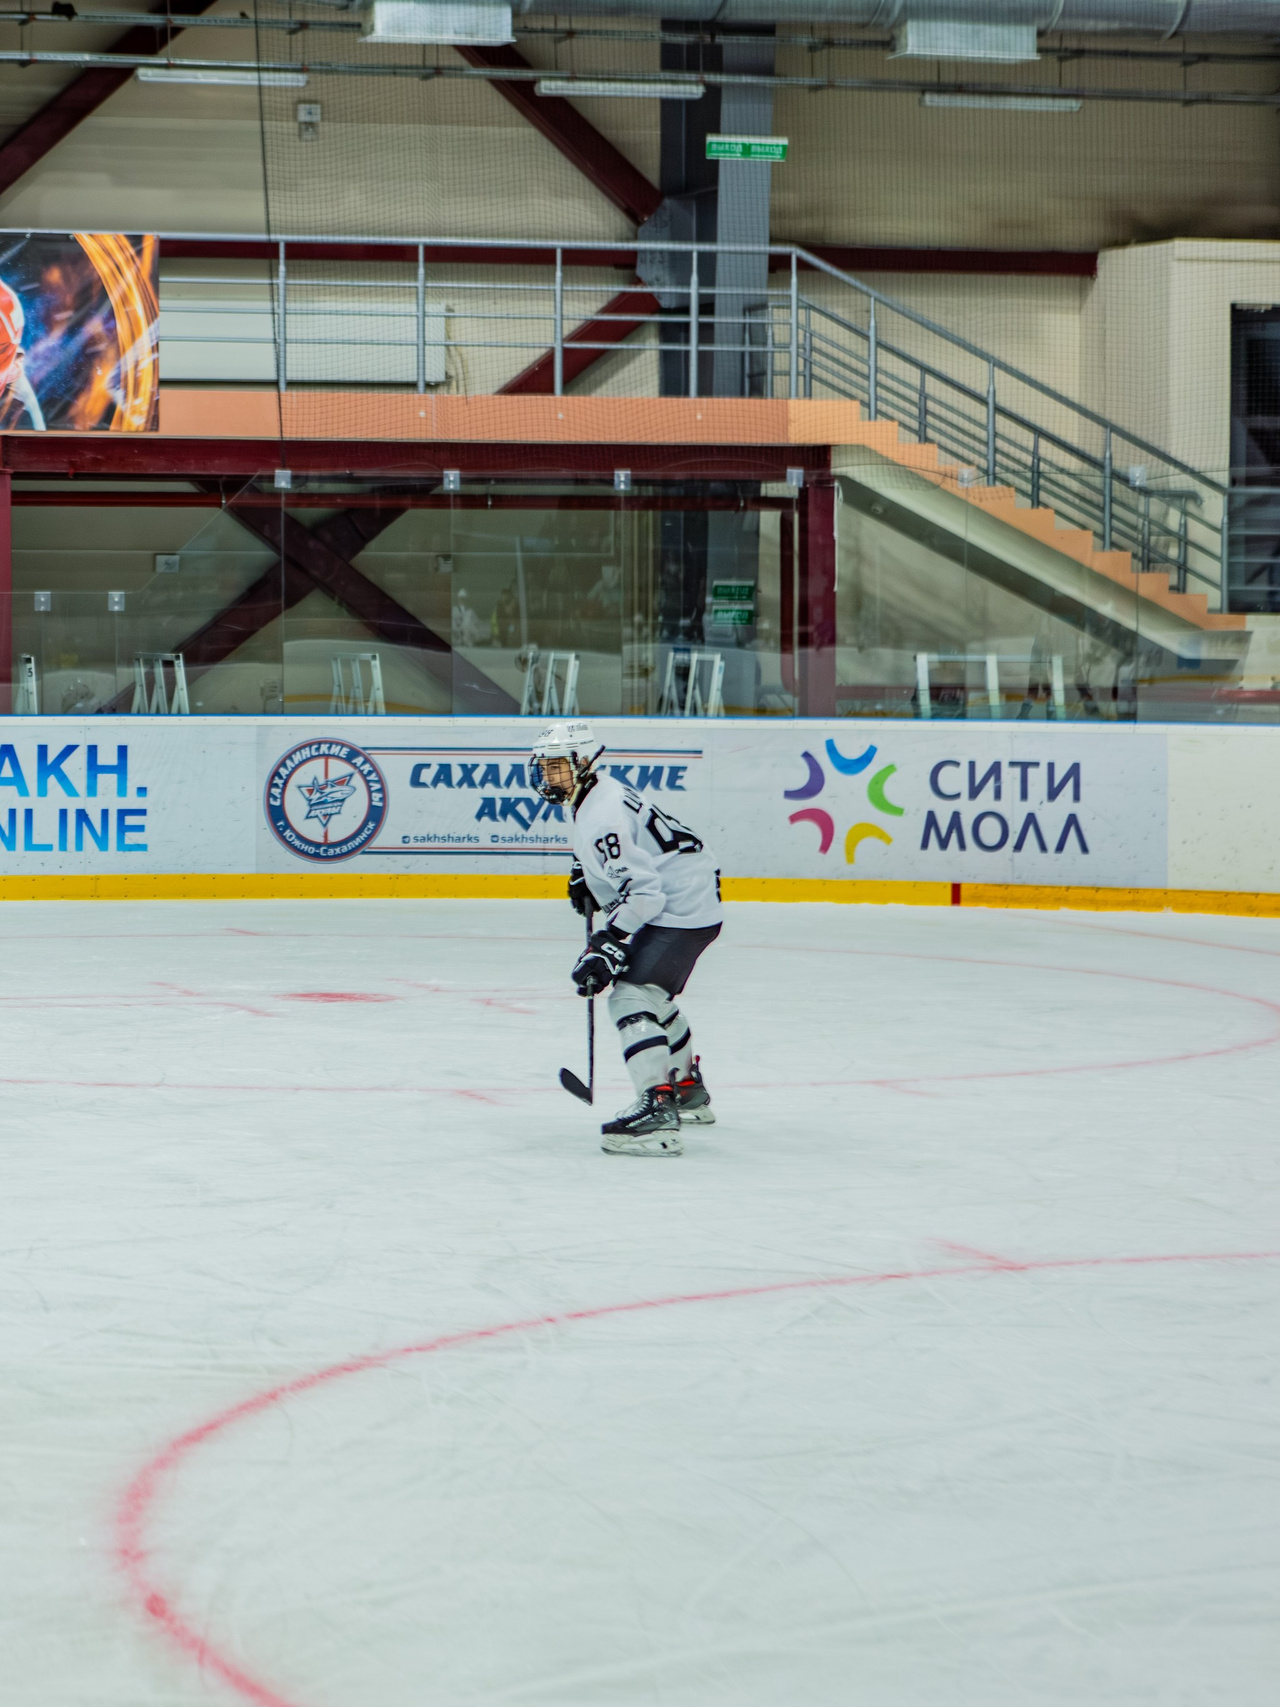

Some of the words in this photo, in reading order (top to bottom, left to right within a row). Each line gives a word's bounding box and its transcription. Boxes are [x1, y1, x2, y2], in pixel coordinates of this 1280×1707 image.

[269, 743, 351, 807] САХАЛИНСКИЕ
[351, 756, 384, 808] АКУЛЫ
[929, 759, 1081, 804] СИТИ
[475, 796, 568, 832] АКУЛ
[282, 821, 377, 857] Южно-Сахалинск
[412, 833, 480, 845] sakhsharks
[501, 834, 569, 845] sakhsharks
[920, 810, 1090, 855] МОЛЛ
